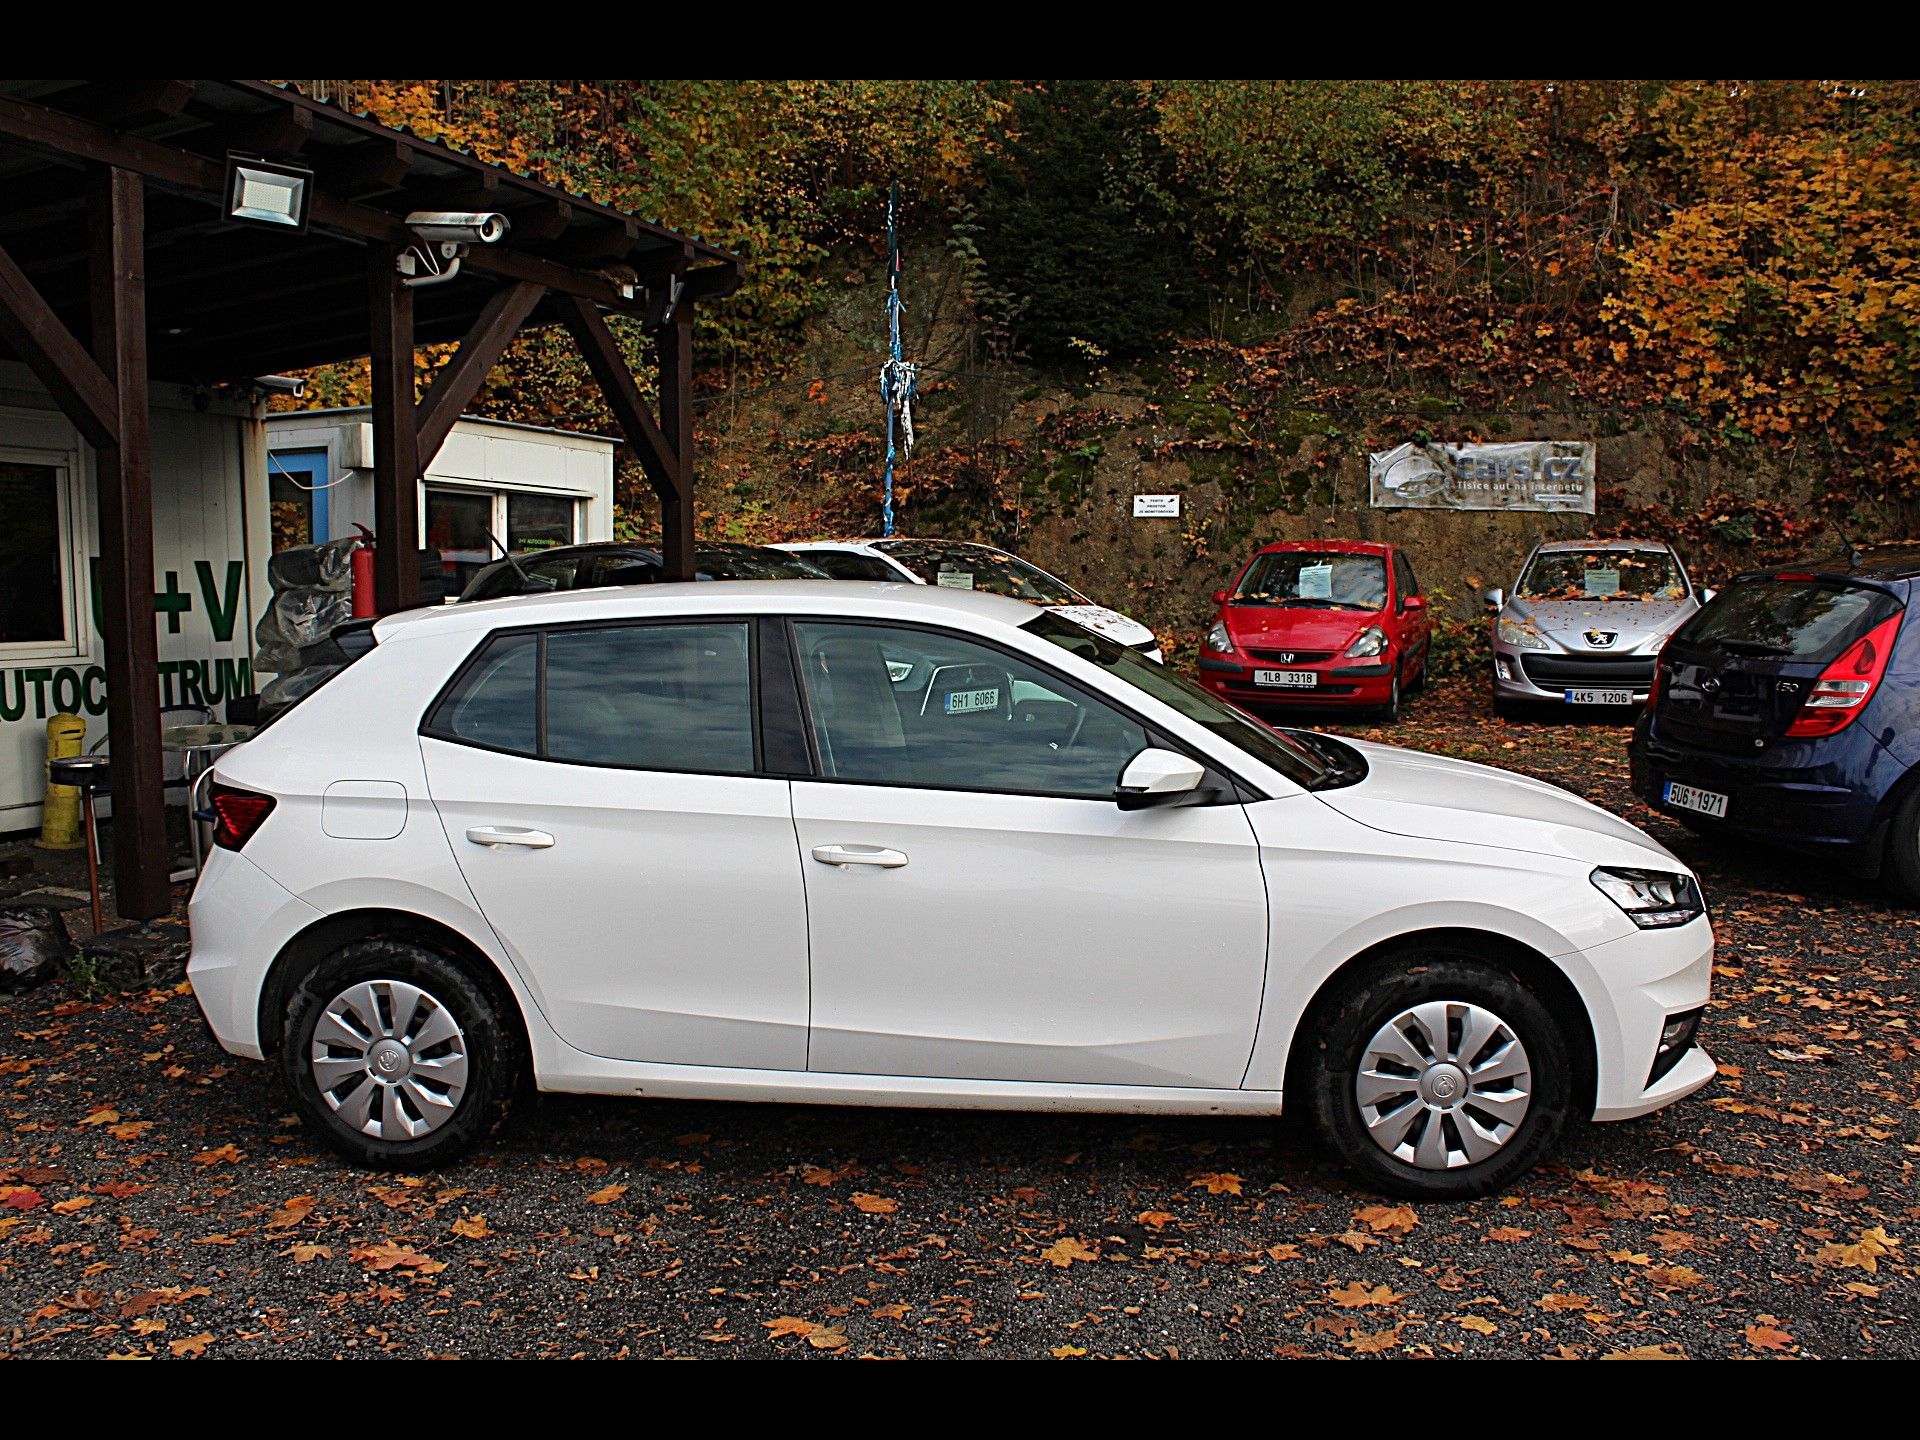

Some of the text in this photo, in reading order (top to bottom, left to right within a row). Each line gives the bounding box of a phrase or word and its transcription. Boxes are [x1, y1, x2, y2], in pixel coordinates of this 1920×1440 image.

[1456, 456, 1584, 481] cars.cz
[1493, 481, 1511, 491] aut
[1531, 481, 1583, 492] internetu
[1263, 671, 1312, 683] 1L8 3318
[952, 691, 995, 708] 6H1 6066
[1574, 692, 1628, 703] 4K5 1206
[1671, 784, 1723, 814] 5U6 1971
